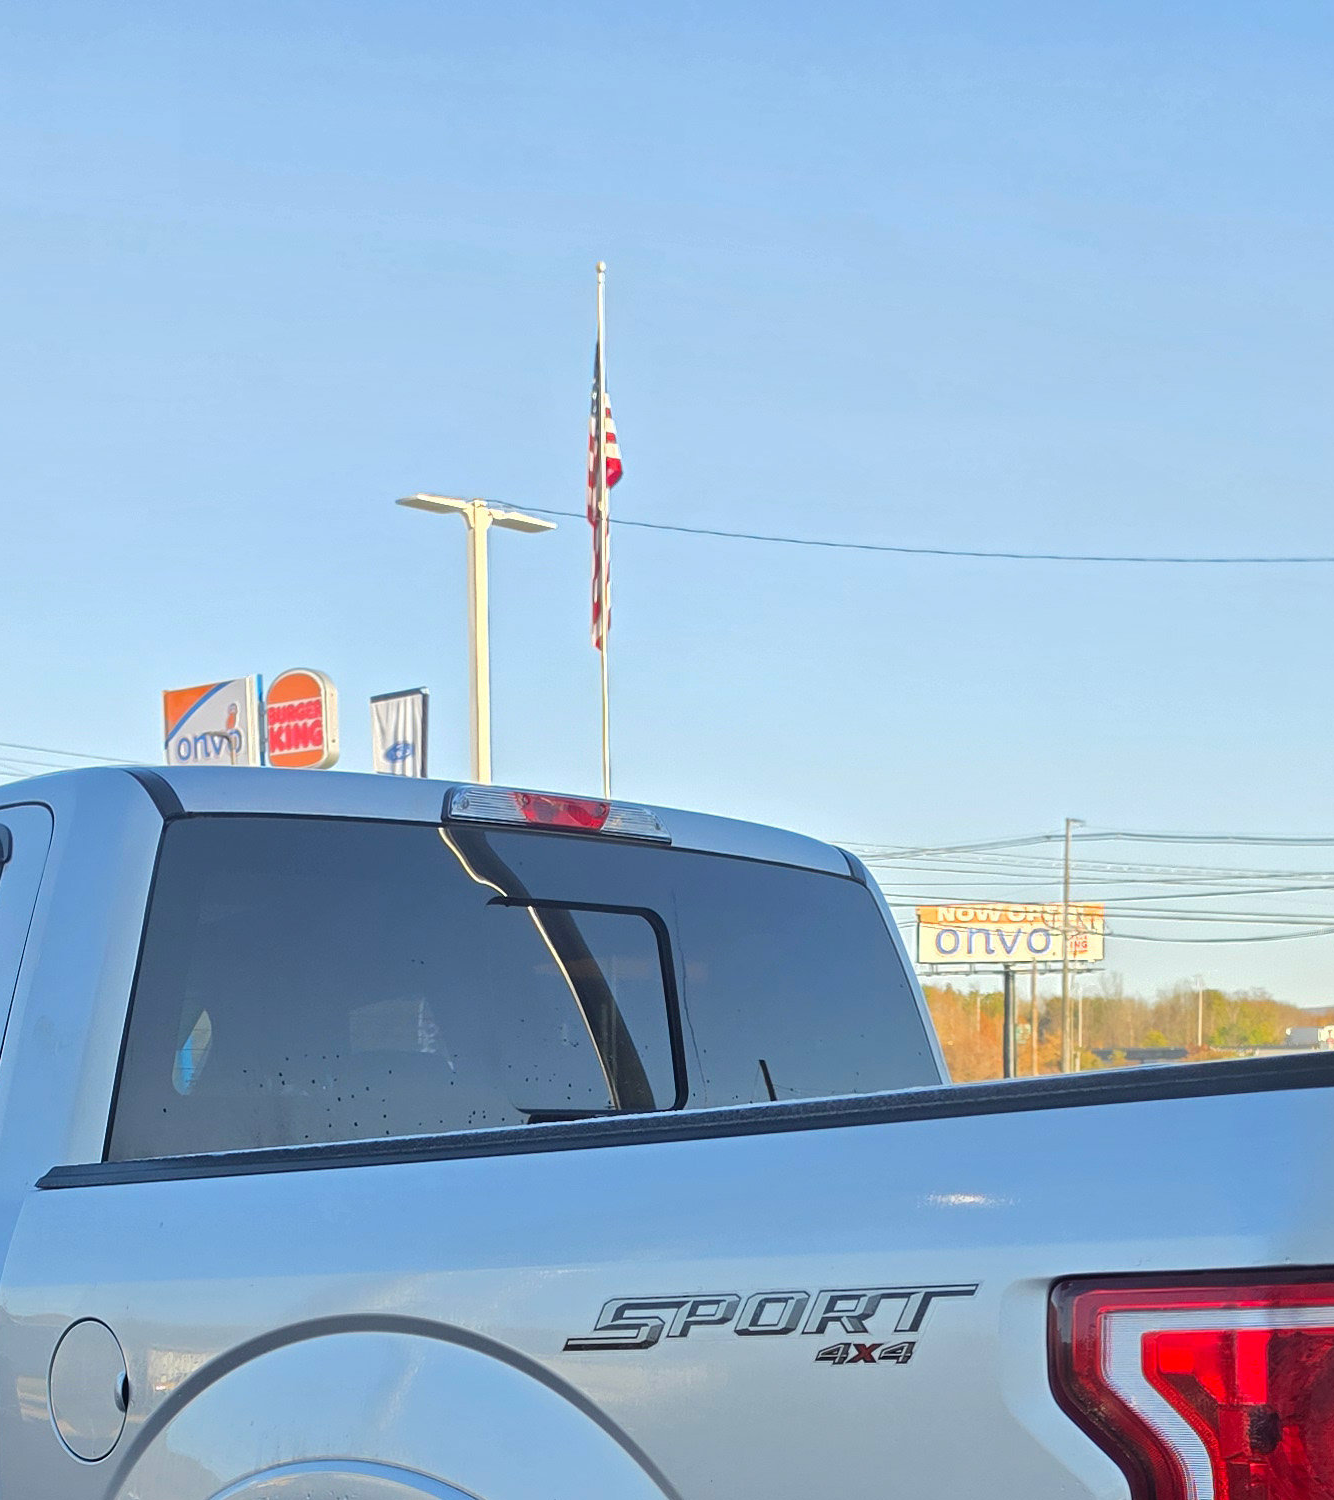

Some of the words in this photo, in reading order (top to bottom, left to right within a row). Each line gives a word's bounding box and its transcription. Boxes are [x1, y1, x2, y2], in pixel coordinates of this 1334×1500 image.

[268, 700, 322, 724] BURGER
[177, 729, 243, 761] onvo
[269, 719, 323, 754] KING
[937, 905, 1001, 922] NOW
[935, 927, 1052, 955] onvo
[562, 1282, 982, 1353] SPORT
